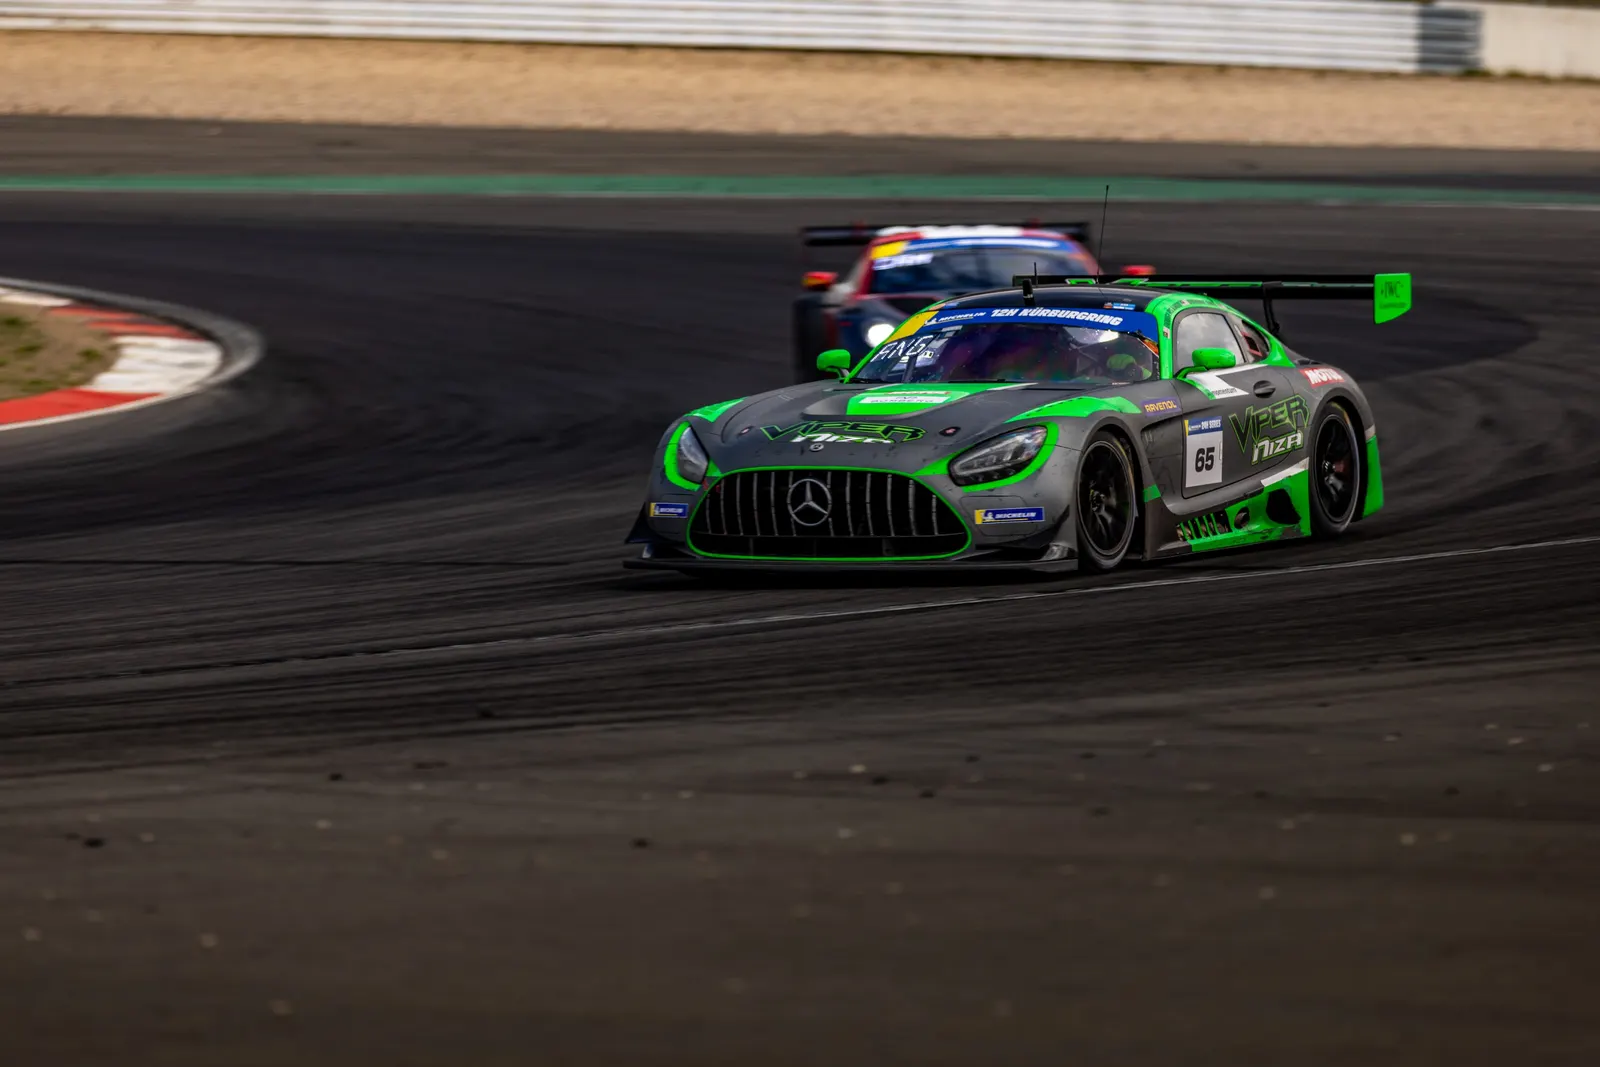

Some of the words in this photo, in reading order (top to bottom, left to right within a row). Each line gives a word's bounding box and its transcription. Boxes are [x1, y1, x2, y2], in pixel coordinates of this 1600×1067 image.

[991, 309, 1019, 317] 12H
[1018, 307, 1123, 326] NÜRBURGRING
[1304, 368, 1344, 385] MOTUL
[1144, 400, 1177, 412] RAVENOL
[1195, 446, 1215, 472] 65
